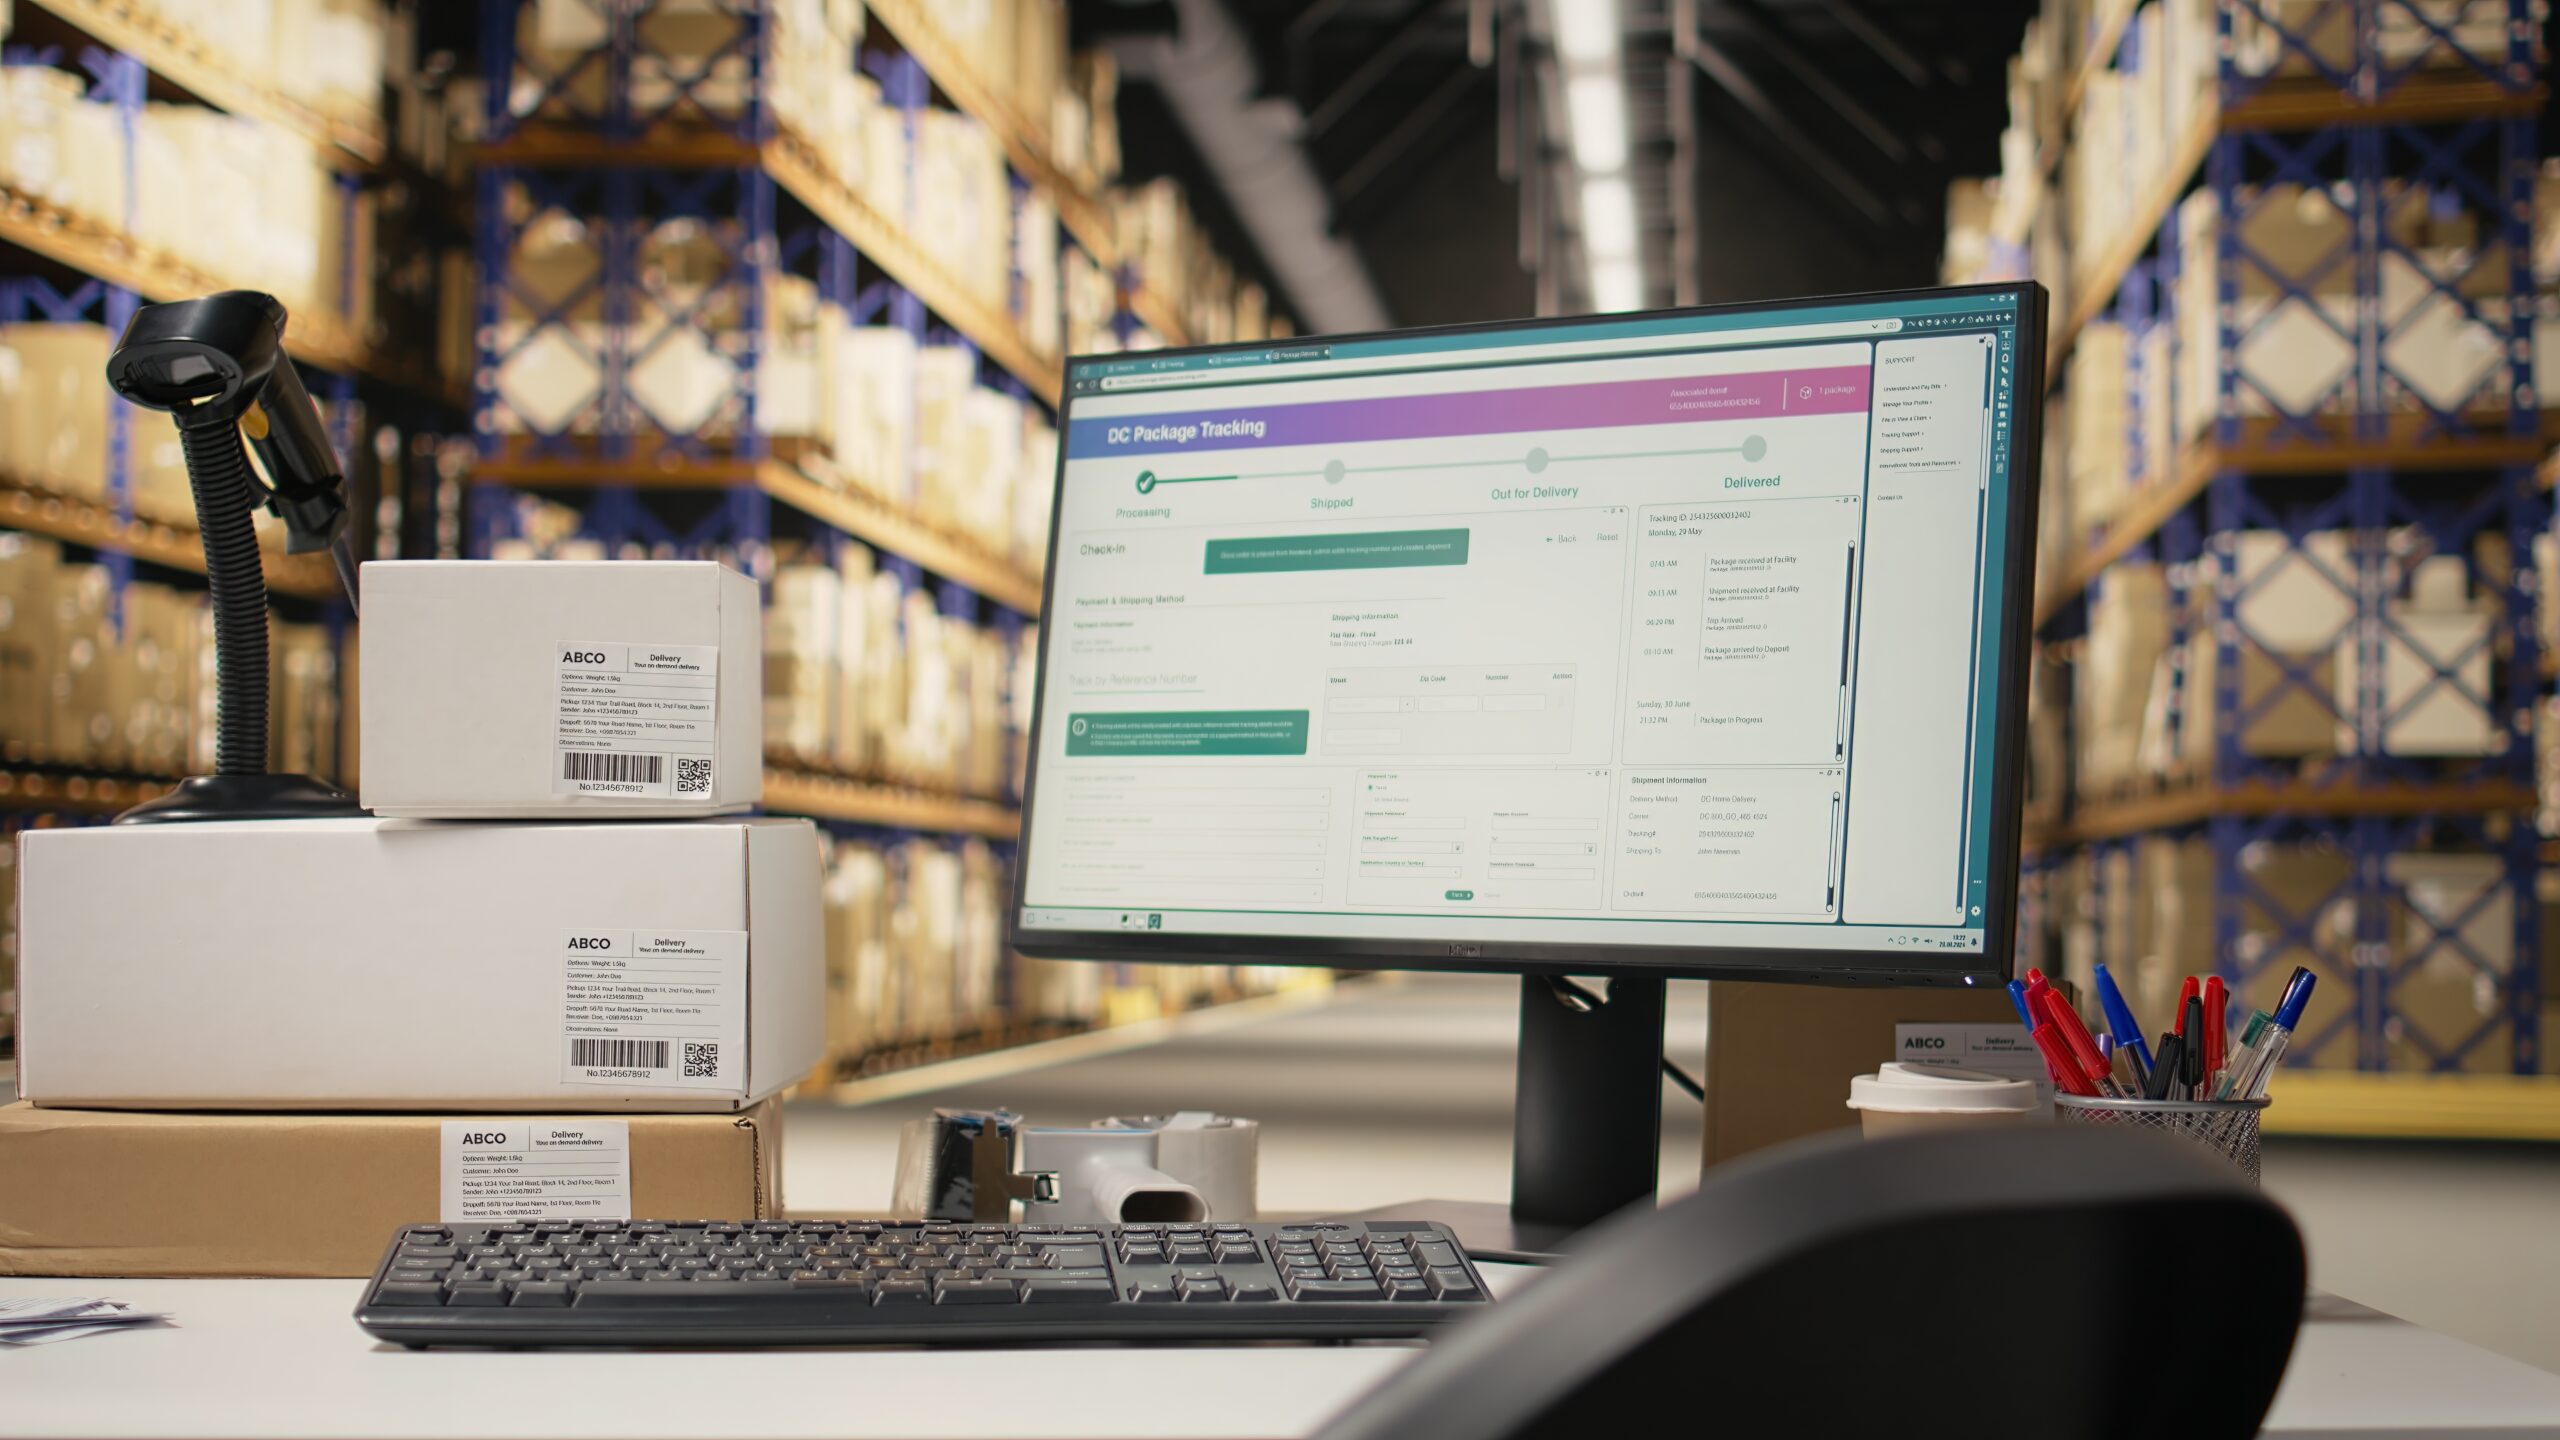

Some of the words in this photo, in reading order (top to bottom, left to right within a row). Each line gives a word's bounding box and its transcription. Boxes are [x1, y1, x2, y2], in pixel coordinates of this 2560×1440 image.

[1824, 385, 1855, 394] package
[1108, 426, 1129, 444] DC
[1134, 423, 1196, 444] Package
[1200, 419, 1266, 438] Tracking
[1724, 475, 1780, 489] Delivered
[1491, 488, 1511, 499] Out
[1515, 488, 1530, 498] for
[1533, 486, 1579, 498] Delivery
[1311, 497, 1354, 510] Shipped
[1116, 507, 1170, 520] Processing
[1649, 513, 1678, 522] Tracking
[1649, 528, 1676, 537] Monday,
[1688, 527, 1702, 537] May
[1080, 543, 1126, 556] Check-in
[1774, 556, 1796, 564] Facility
[1710, 587, 1739, 595] Shipment
[1777, 585, 1800, 593] Facility
[1075, 597, 1108, 606] Payment
[1120, 596, 1152, 605] Shipping
[1156, 595, 1184, 603] Method
[1332, 614, 1360, 622] Shipping
[1705, 646, 1731, 654] Package
[562, 651, 605, 664] ABCO
[650, 654, 681, 663] Delivery
[1637, 700, 1663, 709] Sunday,
[1700, 716, 1727, 724] Package
[1735, 716, 1763, 724] Progress
[1632, 777, 1665, 785] Shipment
[579, 783, 643, 792] No.12345678912
[1732, 795, 1756, 804] Delivery
[568, 937, 610, 949] ABCO
[655, 939, 685, 947] Delivery
[1905, 1037, 1945, 1048] ABCO
[1986, 1037, 2015, 1045] Delivery
[587, 1070, 651, 1078] No.12345678912
[463, 1133, 506, 1144] ABCO
[552, 1131, 583, 1139] Delivery
